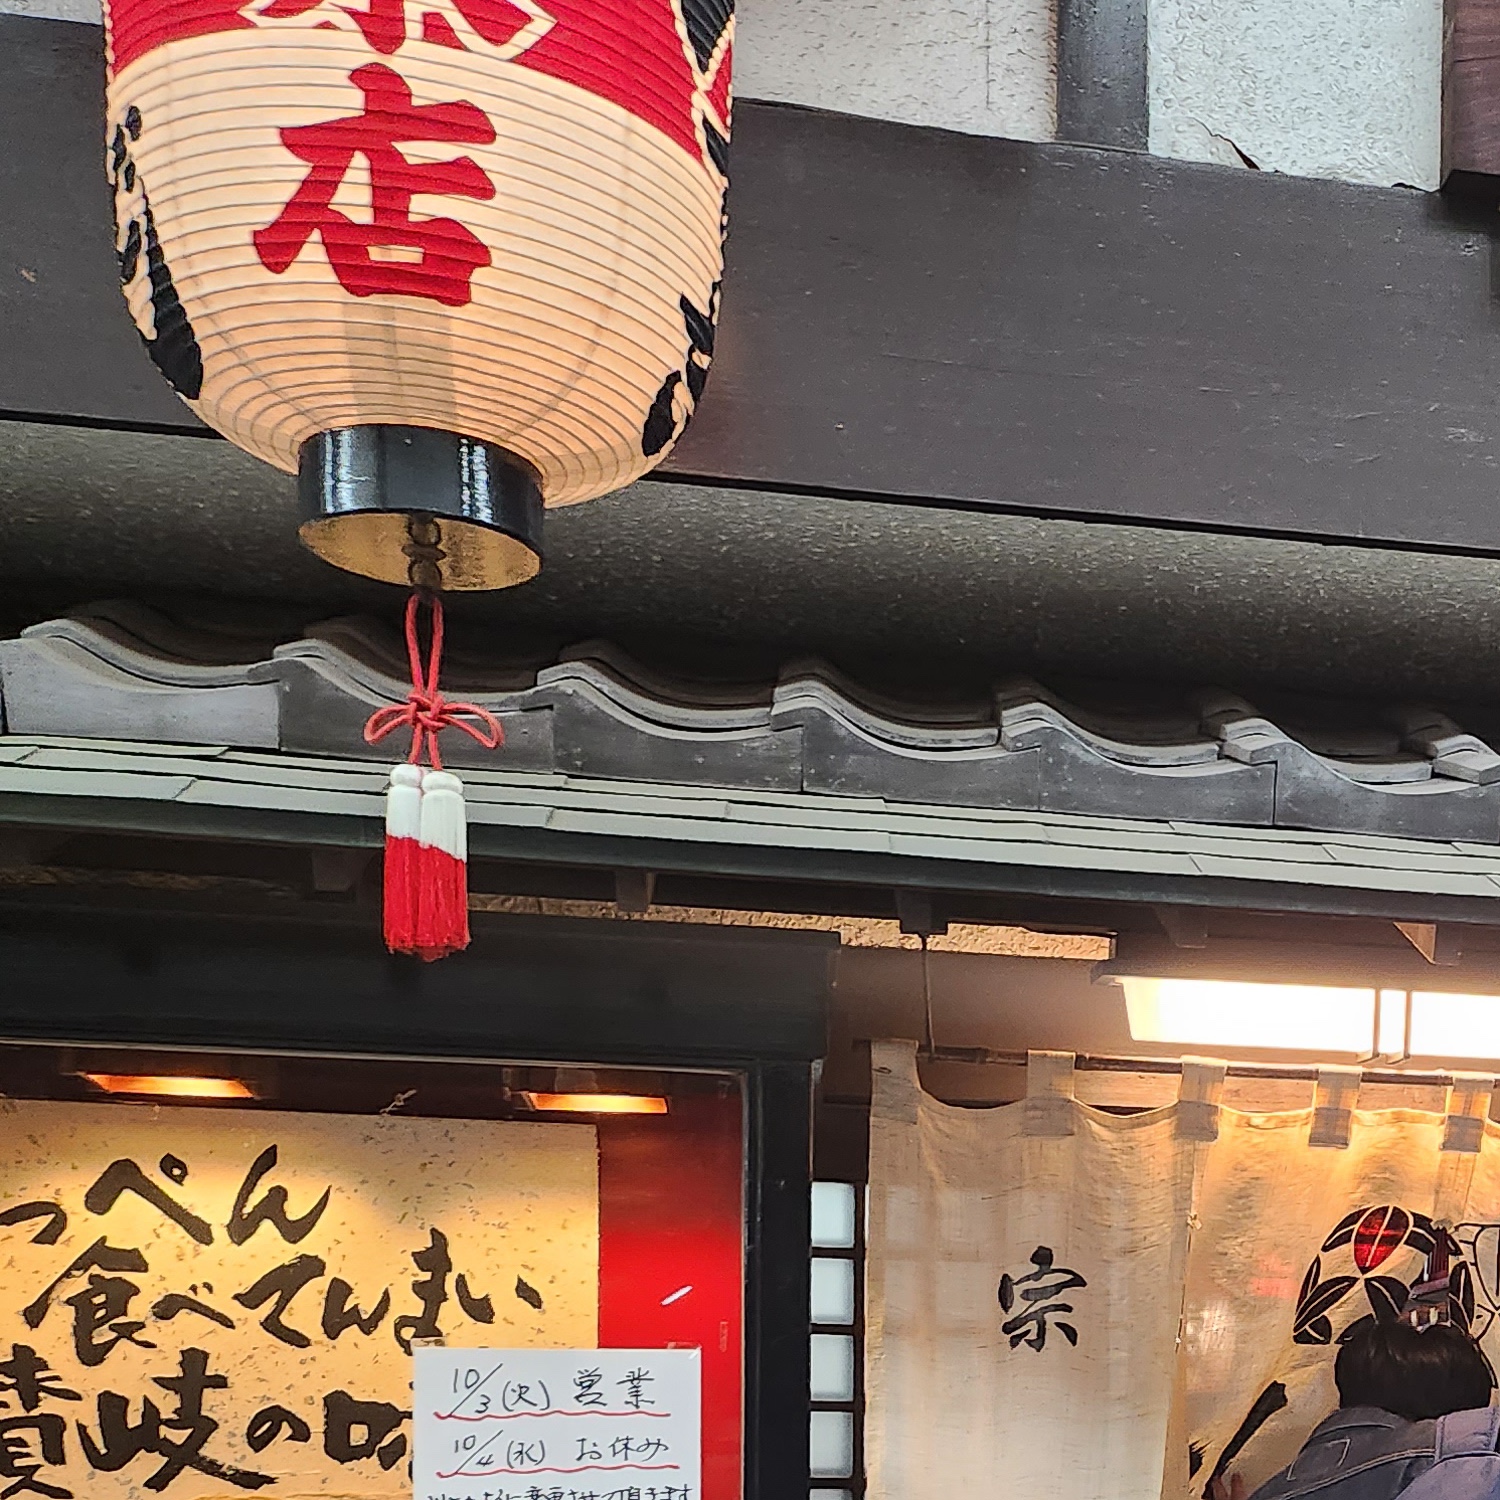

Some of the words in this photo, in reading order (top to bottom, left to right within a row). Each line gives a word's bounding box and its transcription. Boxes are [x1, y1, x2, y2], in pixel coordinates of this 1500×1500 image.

[237, 0, 557, 307] 店
[998, 1245, 1088, 1352] 宗
[573, 1367, 656, 1409] 営業
[575, 1436, 669, 1463] お休み
